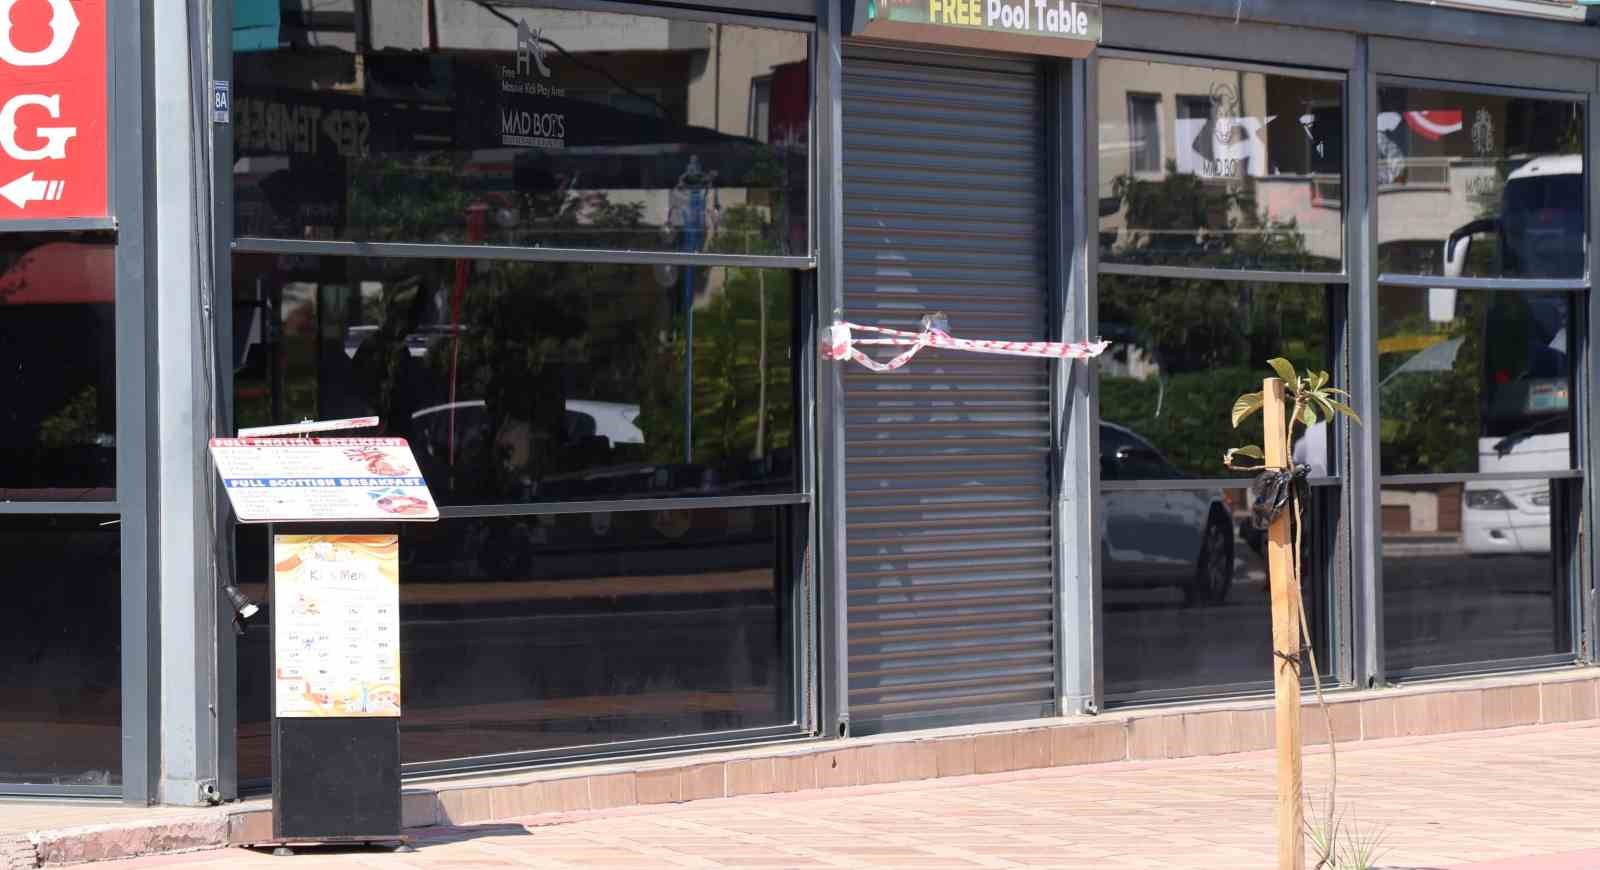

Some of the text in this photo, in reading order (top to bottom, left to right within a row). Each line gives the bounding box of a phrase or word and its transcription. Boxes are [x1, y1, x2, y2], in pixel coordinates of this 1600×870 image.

[930, 0, 1089, 35] FREE Pool Table
[502, 110, 531, 136] MAD
[230, 478, 422, 488] FULL SCOTTISH BREAKFAST
